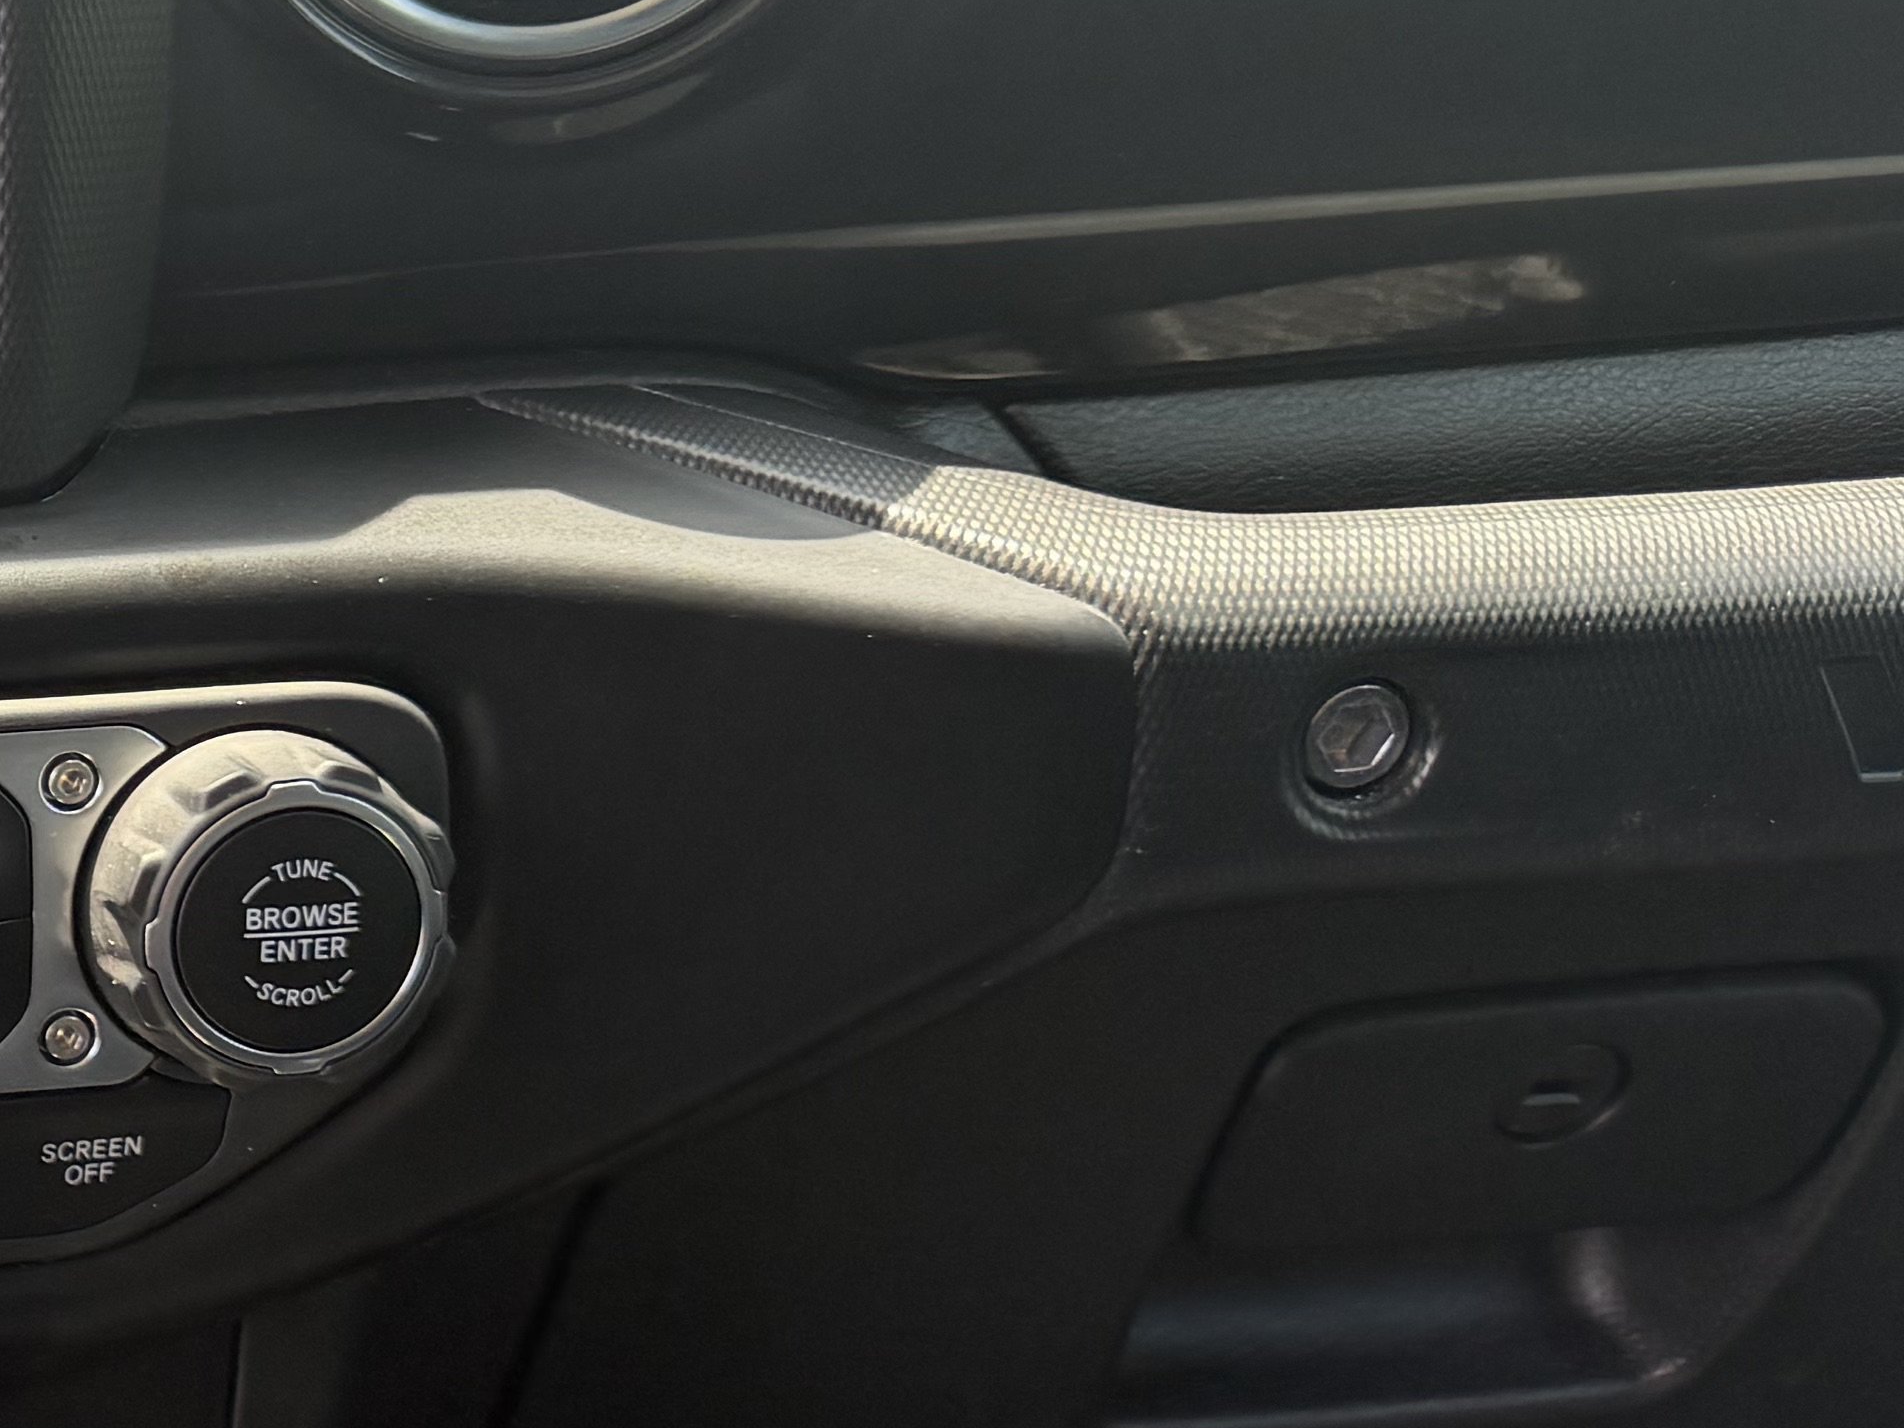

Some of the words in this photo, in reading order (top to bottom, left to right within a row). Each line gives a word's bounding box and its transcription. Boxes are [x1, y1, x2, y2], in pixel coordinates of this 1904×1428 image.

[271, 858, 335, 881] TUNE
[245, 902, 359, 930] BROWSE
[259, 936, 348, 963] ENTER
[256, 979, 344, 1006] SCROLL
[41, 1135, 144, 1164] SCREEN
[64, 1161, 115, 1186] OFF
